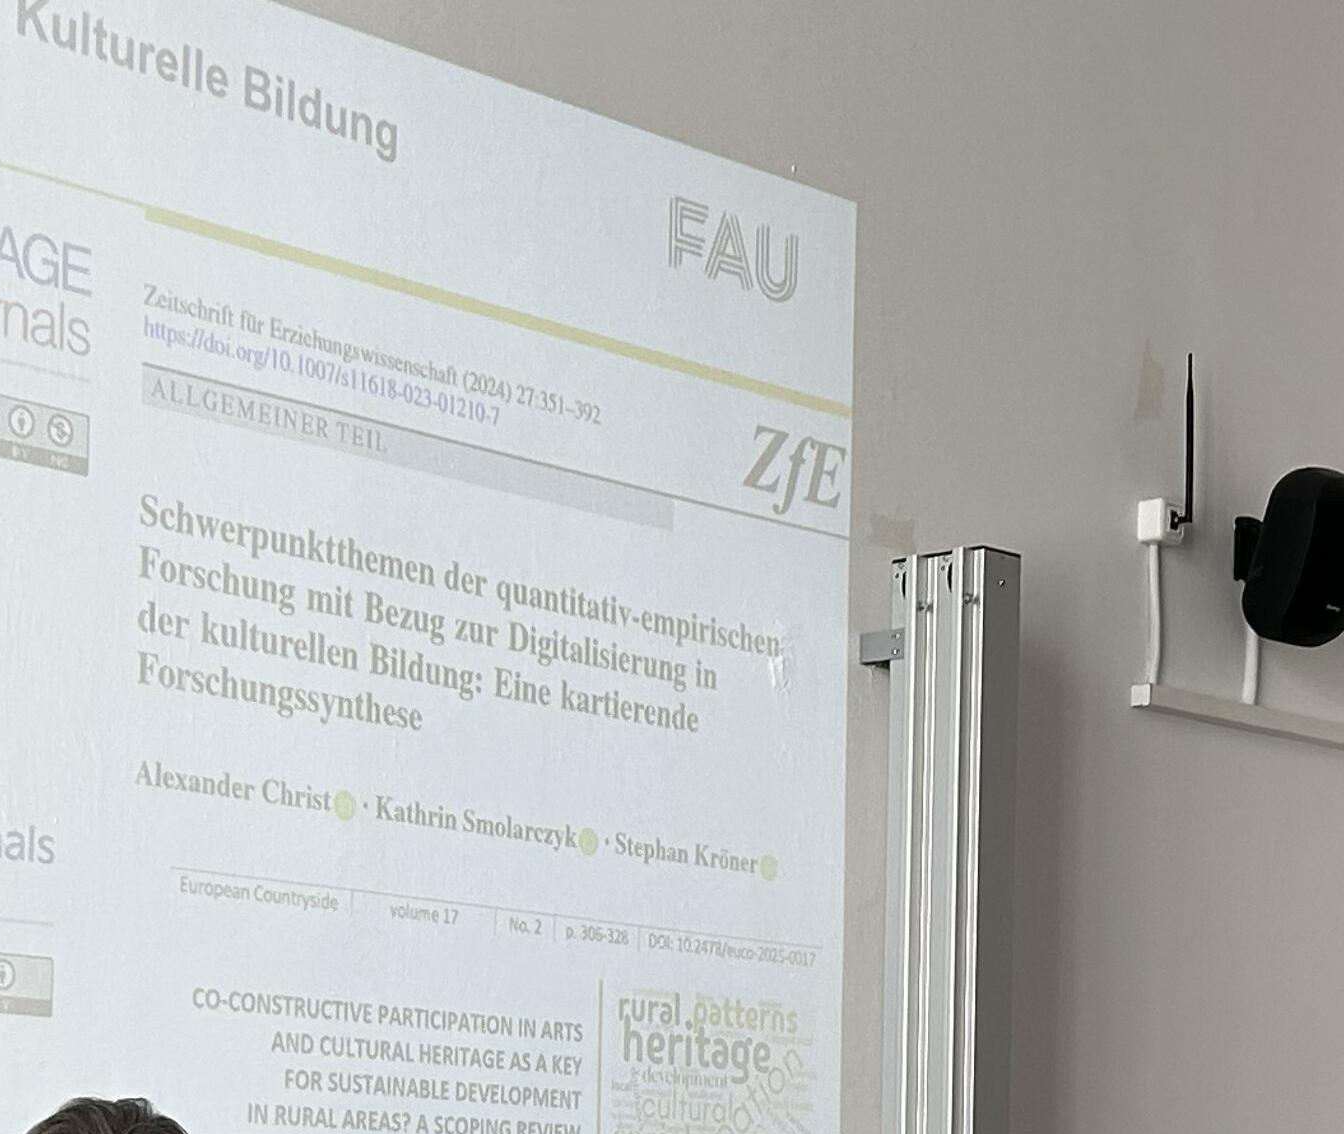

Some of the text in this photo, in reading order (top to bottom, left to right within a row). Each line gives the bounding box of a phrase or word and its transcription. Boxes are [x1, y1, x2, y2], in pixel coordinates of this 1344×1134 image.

[14, 0, 399, 163] Kulturelle Bildung
[667, 195, 799, 304] FAU
[151, 377, 387, 454] ALLGEMEINER TEIL
[743, 423, 847, 516] ZfE
[140, 493, 487, 597] Schwerpunktthemen der
[139, 544, 716, 693] Forschung mit Bezug zur Digitalisierung in
[138, 603, 698, 732] der kulturellen Bildung: Eine kartierende
[138, 651, 422, 731] Forschungssynthese
[135, 761, 759, 875] Alexander Christ Kathrin Smolarczyk Stephan Kröner
[179, 875, 529, 934] European Countryside volume 17 No.
[193, 987, 583, 1042] CO-CONSTRUCTIVE PARTICIPATION IN ARTS
[618, 992, 681, 1026] rural
[271, 1031, 582, 1075] AND CULTURAL HERITAGE AS A KEY
[623, 1013, 772, 1085] heritage
[248, 1103, 268, 1124] IN
[275, 1104, 337, 1129] RURAL
[342, 1109, 411, 1133] AREAS?
[416, 1114, 429, 1134] A
[285, 1069, 322, 1092] FOR
[328, 1072, 449, 1100] SUSTAINABLE
[456, 1081, 582, 1109] DEVELOPMENT
